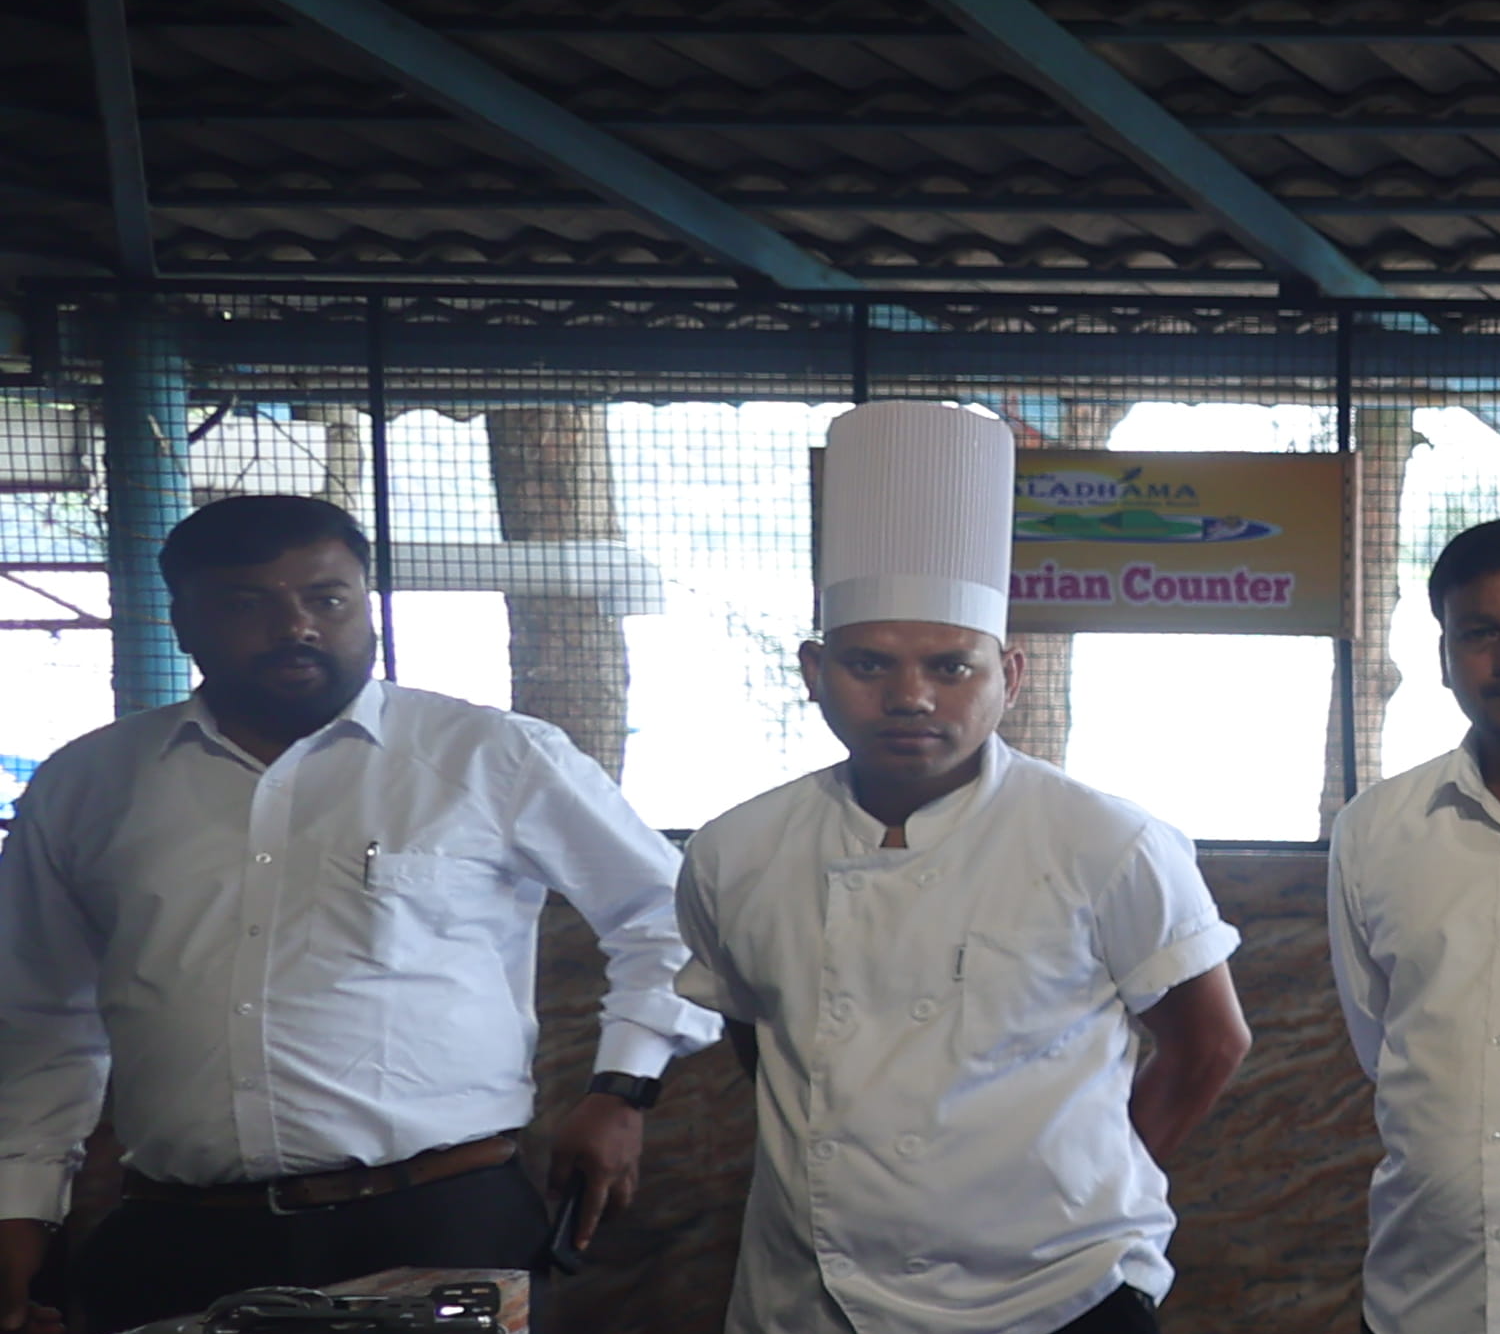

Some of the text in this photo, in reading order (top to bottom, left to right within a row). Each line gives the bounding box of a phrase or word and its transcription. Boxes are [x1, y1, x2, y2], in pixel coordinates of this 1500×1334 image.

[1014, 481, 1197, 500] LADHAMA
[1009, 564, 1292, 603] arian Counter
